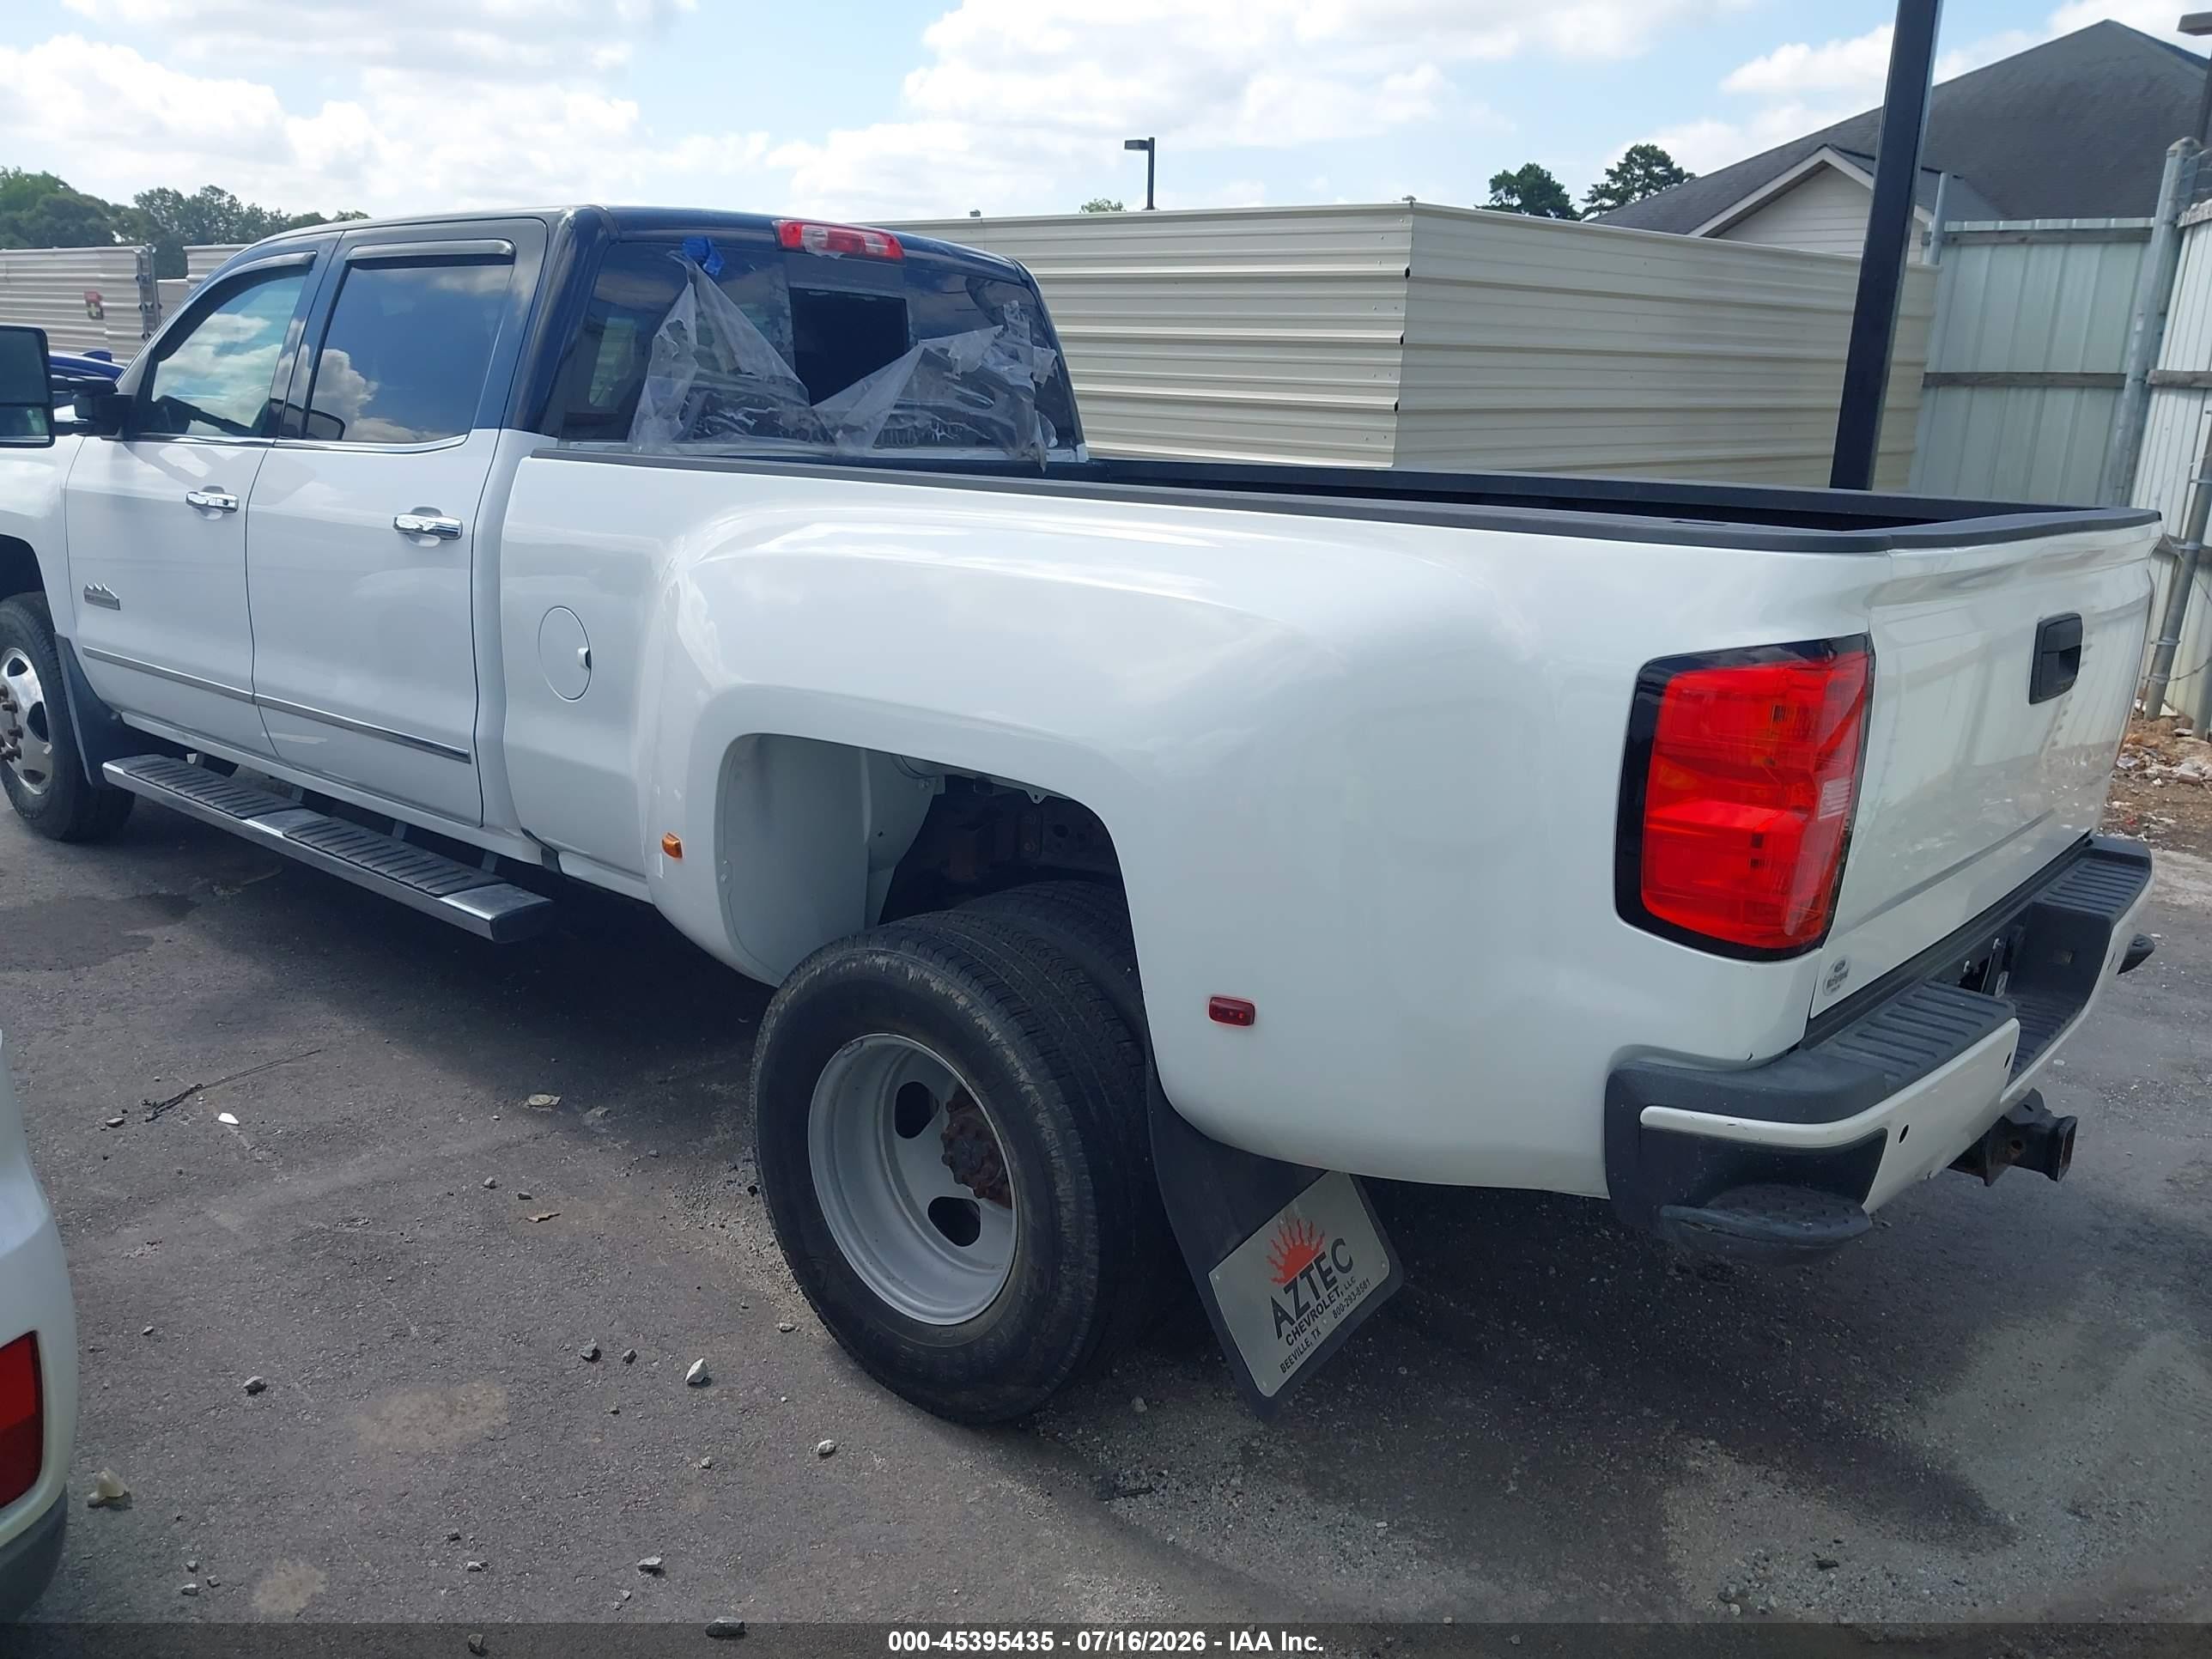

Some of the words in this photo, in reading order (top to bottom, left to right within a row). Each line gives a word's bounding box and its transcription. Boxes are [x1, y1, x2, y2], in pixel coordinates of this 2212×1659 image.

[1270, 1238, 1353, 1340] AZTEC
[1285, 1285, 1344, 1346] CHEVROLET,
[1279, 1338, 1313, 1373] BEEVILLE,
[1310, 1326, 1322, 1340] TX
